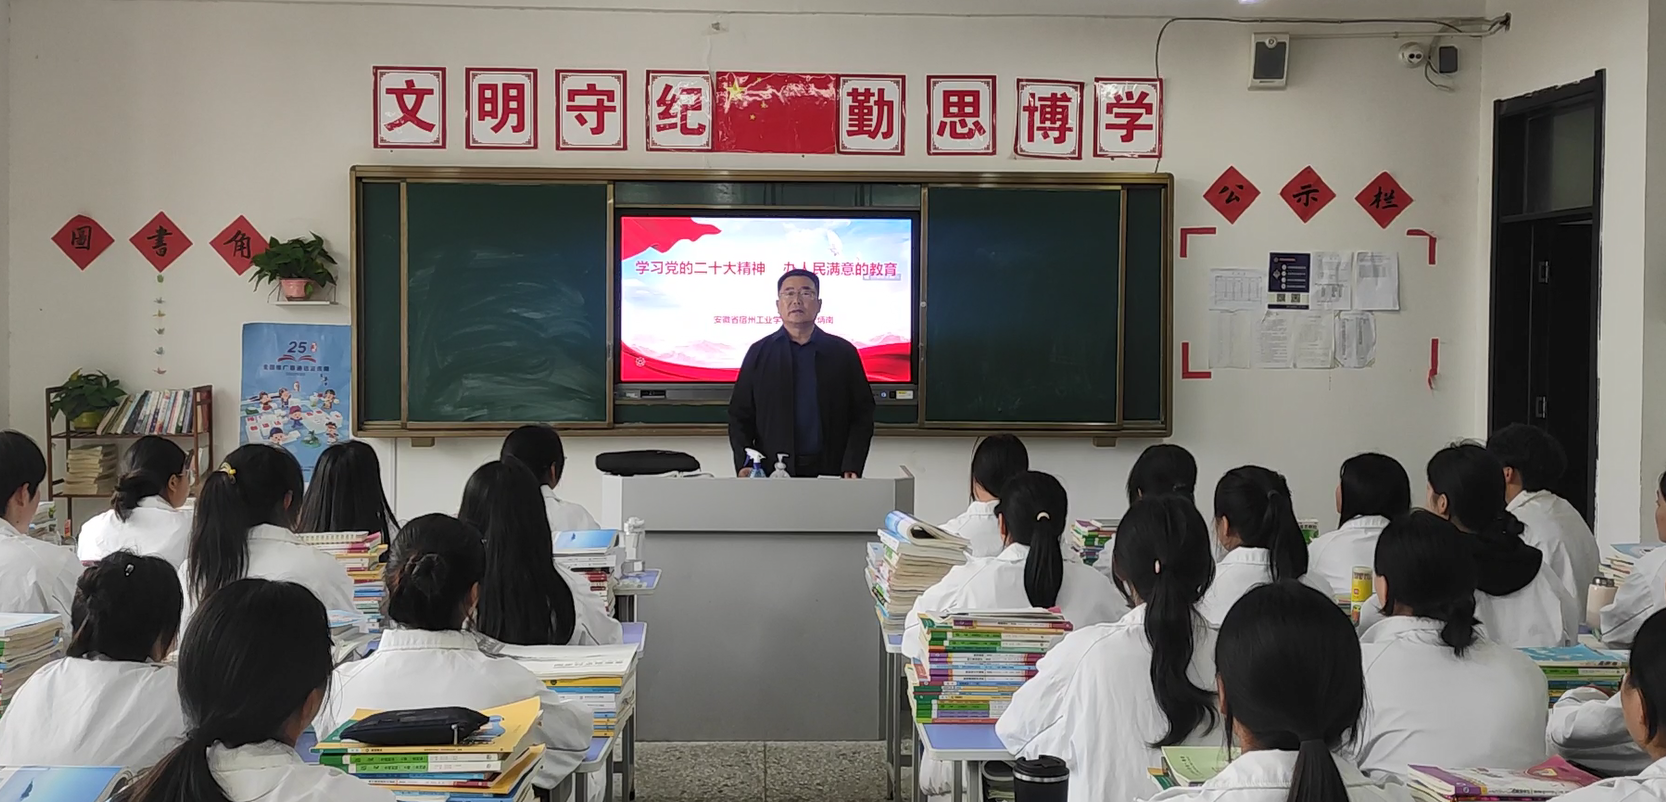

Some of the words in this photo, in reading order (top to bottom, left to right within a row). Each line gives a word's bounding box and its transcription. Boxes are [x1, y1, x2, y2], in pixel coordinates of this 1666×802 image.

[384, 79, 706, 137] 文明守纪
[846, 87, 1154, 144] 勤思博学
[1218, 184, 1399, 209] 公示栏
[71, 225, 253, 260] 圖書角
[635, 260, 767, 275] 学习党的二十大精神
[287, 341, 308, 354] 25
